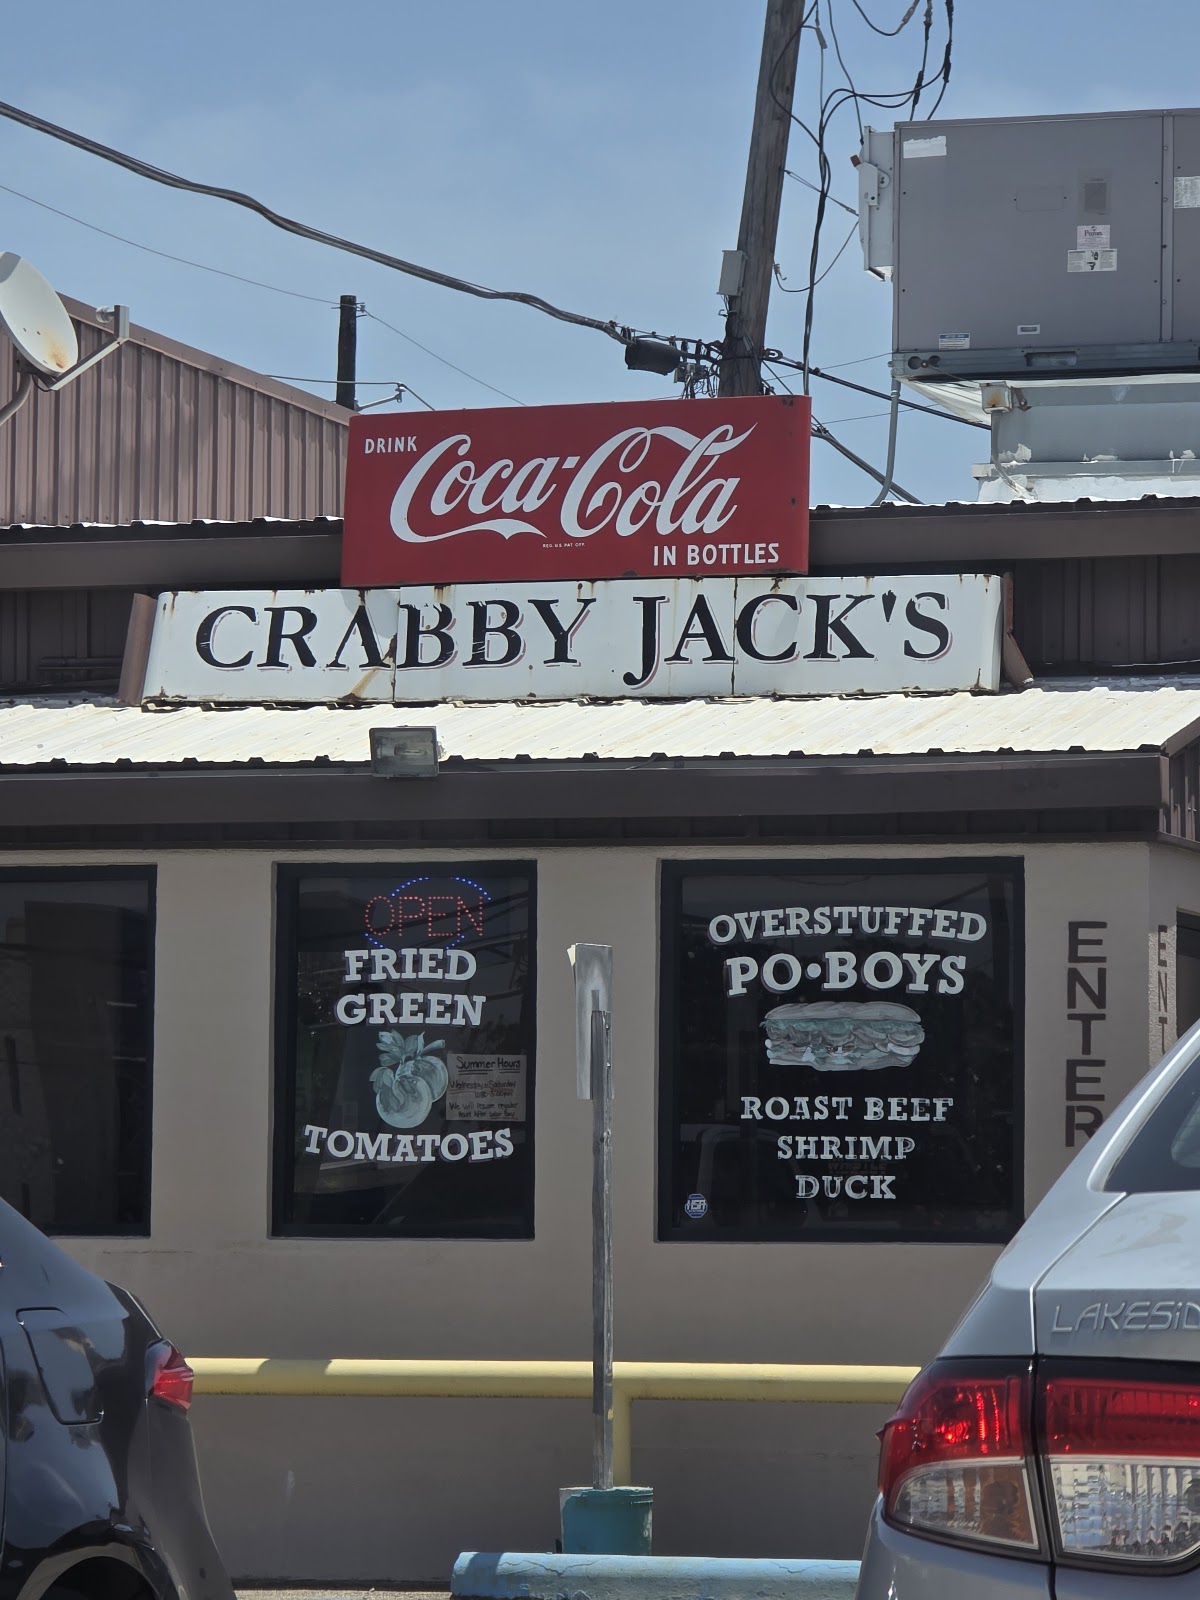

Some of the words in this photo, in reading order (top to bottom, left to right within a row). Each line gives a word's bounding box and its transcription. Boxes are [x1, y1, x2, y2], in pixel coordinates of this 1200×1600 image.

[364, 435, 418, 454] DRINK
[389, 422, 759, 543] Coca-Cola
[653, 545, 677, 567] IN
[687, 543, 780, 566] BOTTLES
[195, 596, 597, 671] CRABBY
[622, 591, 953, 691] JACK'S
[364, 895, 484, 937] OPEN
[708, 906, 988, 943] OVERSTUFFED
[343, 948, 477, 982] FRIED
[335, 992, 487, 1027] GREEN
[1065, 921, 1108, 1147] ENTER
[456, 1056, 496, 1069] Summer
[497, 1056, 521, 1069] Hours
[449, 1102, 461, 1110] We
[740, 1095, 853, 1121] ROAST
[863, 1097, 954, 1122] BEEF
[303, 1125, 514, 1163] TOMATOES
[777, 1135, 916, 1161] SHRIMP
[795, 1175, 897, 1200] DUCK
